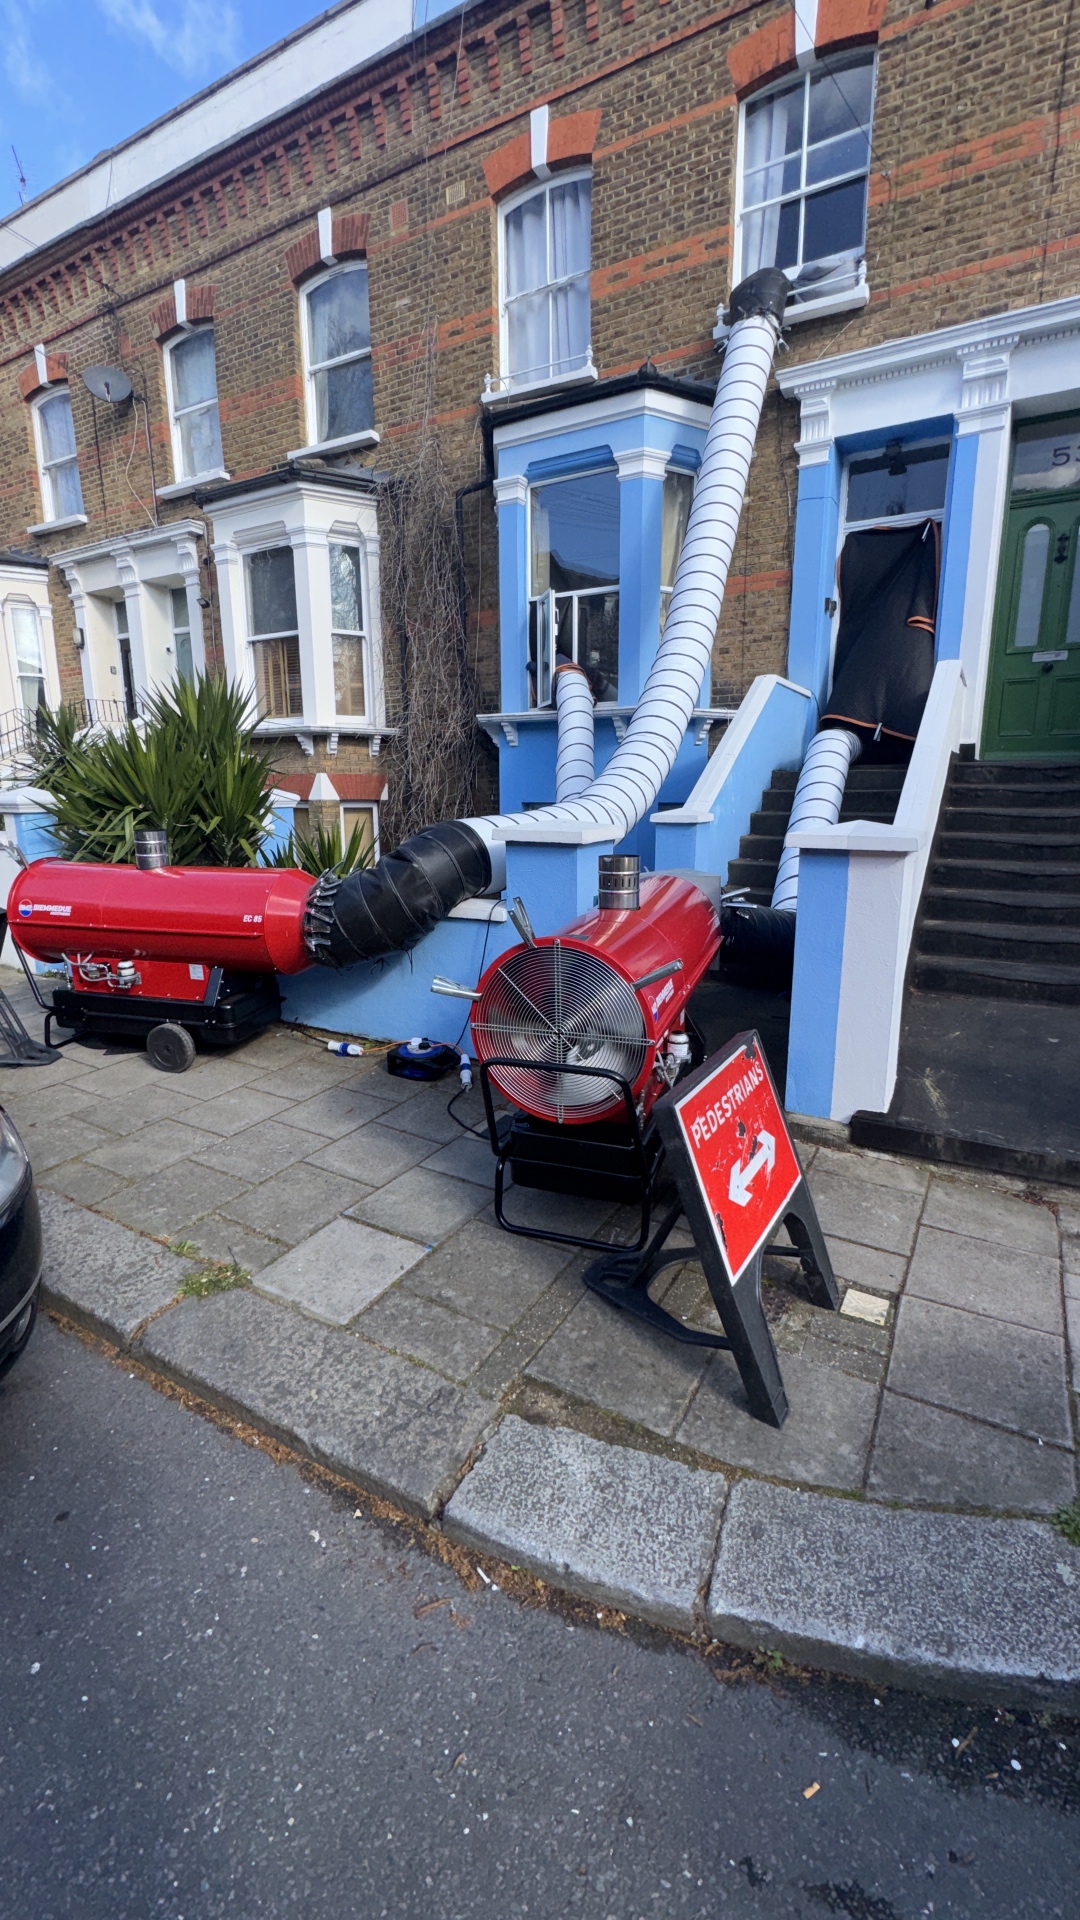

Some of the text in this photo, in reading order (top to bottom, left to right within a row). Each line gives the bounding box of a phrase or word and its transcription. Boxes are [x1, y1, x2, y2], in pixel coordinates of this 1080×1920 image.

[1052, 445, 1080, 466] 5
[243, 915, 262, 923] EC 85
[691, 1061, 764, 1149] PEDESTRIANS
